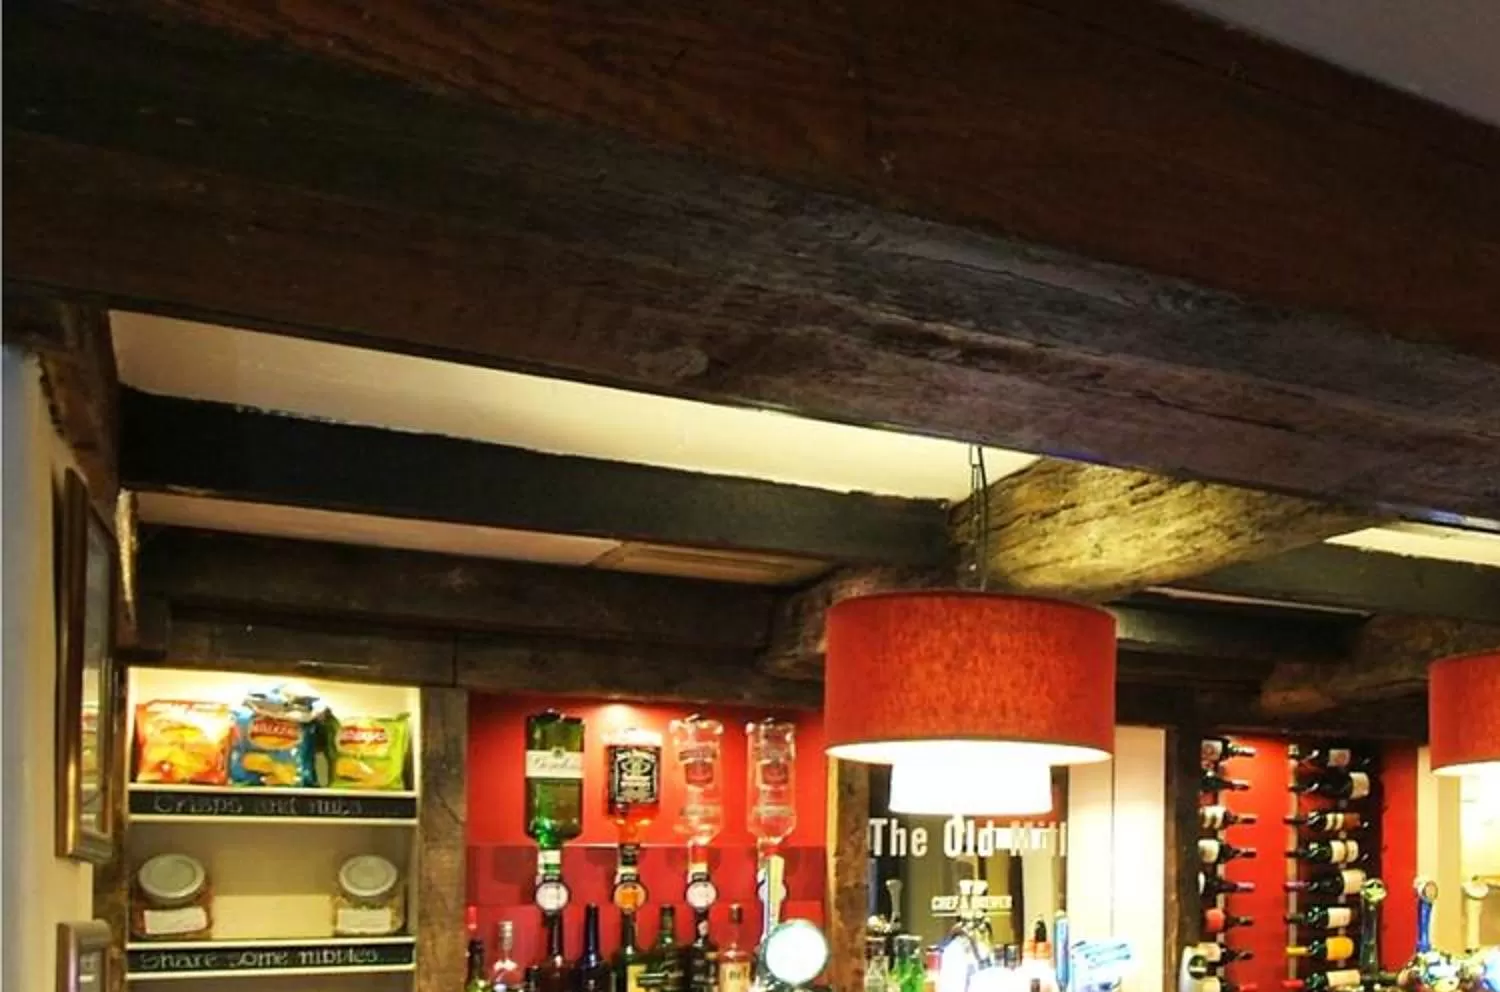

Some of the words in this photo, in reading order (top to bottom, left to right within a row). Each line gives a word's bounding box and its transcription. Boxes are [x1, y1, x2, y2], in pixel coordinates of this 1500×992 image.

[869, 817, 928, 857] The
[943, 818, 994, 858] Old
[139, 953, 217, 970] Share
